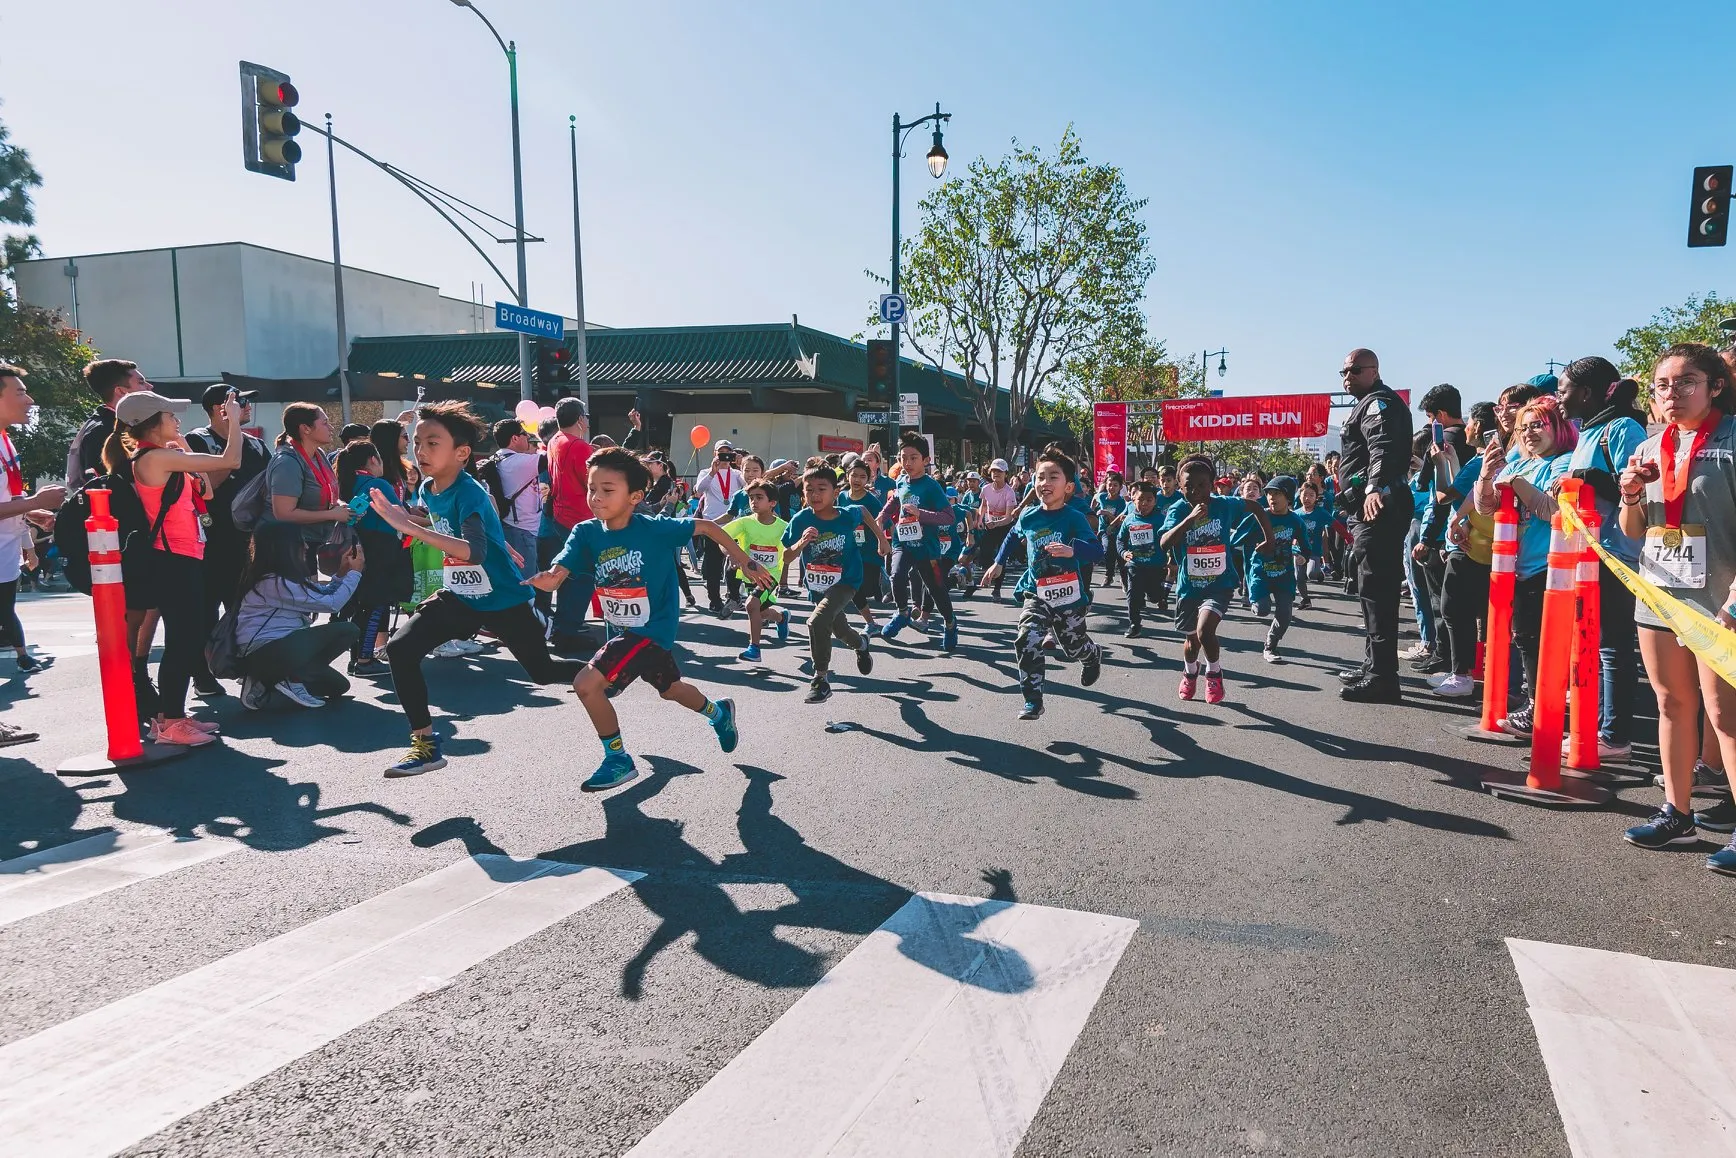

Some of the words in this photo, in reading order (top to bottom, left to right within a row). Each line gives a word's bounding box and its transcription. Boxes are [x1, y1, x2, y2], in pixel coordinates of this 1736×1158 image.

[886, 298, 902, 319] P
[501, 308, 559, 335] Broadway
[1165, 403, 1196, 411] firecracker
[1189, 413, 1253, 428] KIDDIE
[1259, 411, 1302, 425] RUN
[899, 525, 918, 536] 9318
[753, 553, 775, 563] 9623
[1653, 545, 1695, 562] 7244
[1193, 556, 1221, 569] 9655
[451, 570, 482, 585] 9830
[807, 572, 836, 585] 9198
[1044, 585, 1074, 601] 9580
[605, 599, 642, 616] 9270
